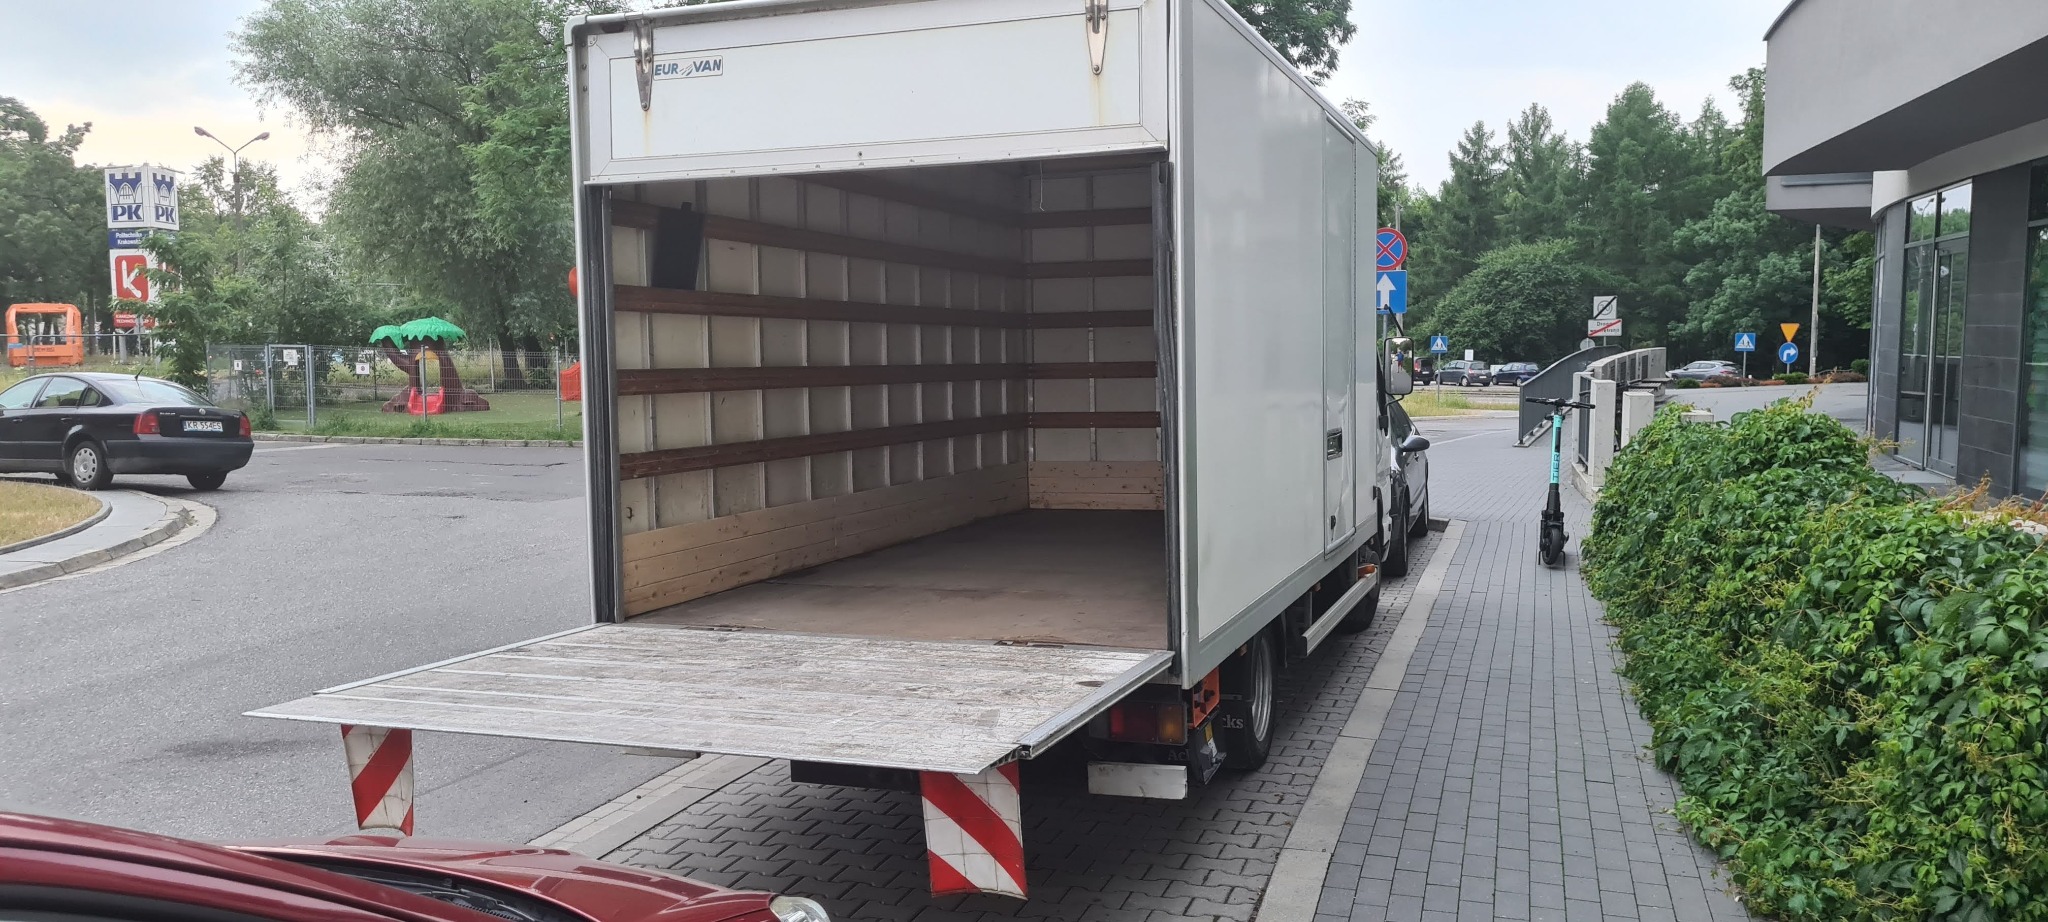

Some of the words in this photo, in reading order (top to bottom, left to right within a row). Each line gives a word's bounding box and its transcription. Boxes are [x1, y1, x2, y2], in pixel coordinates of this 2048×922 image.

[113, 205, 142, 220] PK
[155, 205, 175, 223] PK
[187, 421, 198, 430] KR
[1552, 453, 1560, 480] TIER
